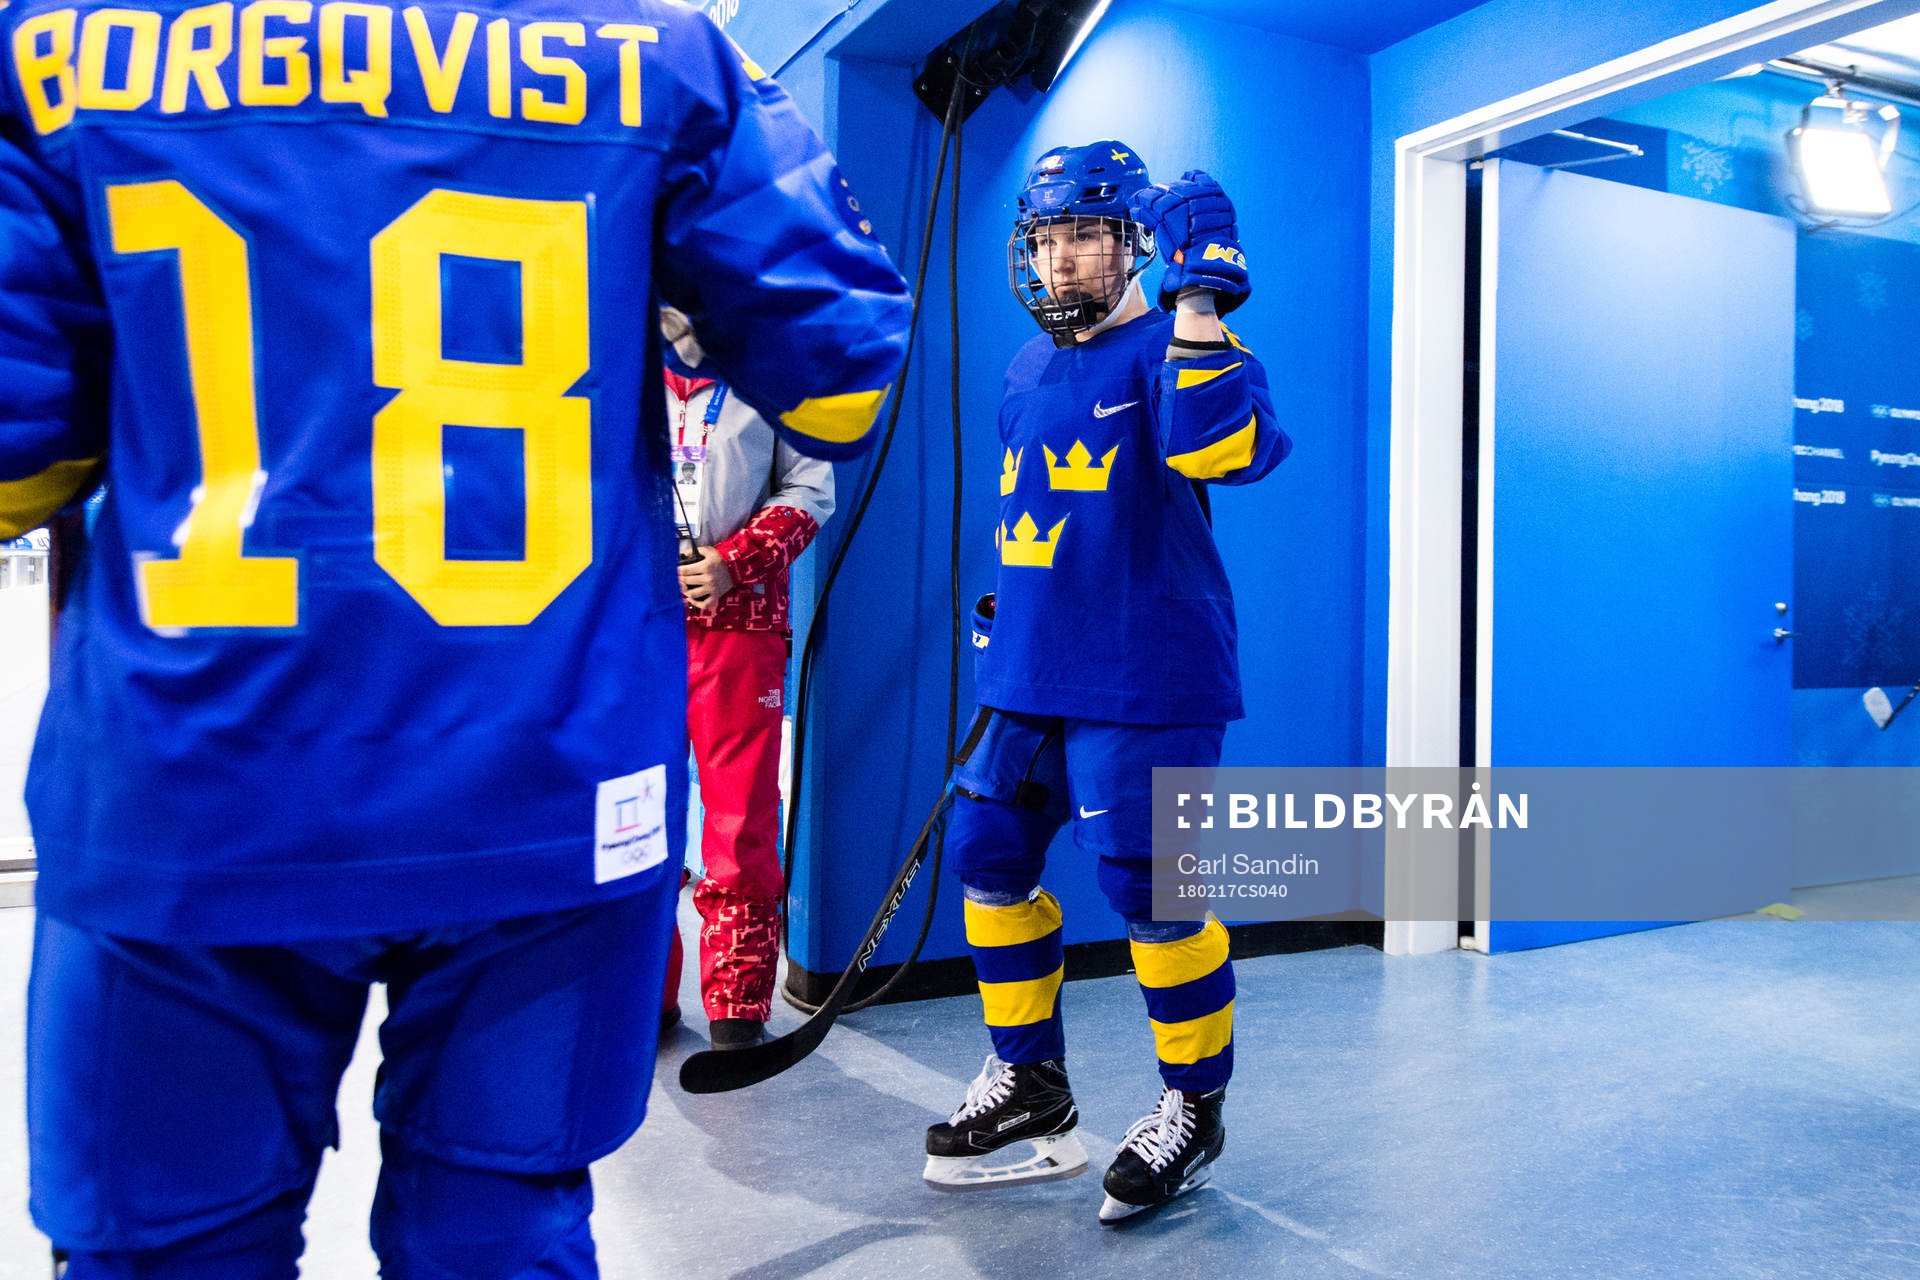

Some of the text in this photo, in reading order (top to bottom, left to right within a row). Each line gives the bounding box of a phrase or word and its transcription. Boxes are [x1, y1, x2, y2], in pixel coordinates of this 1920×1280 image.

[13, 0, 659, 135] BORGQVIST
[106, 180, 593, 628] 18
[858, 859, 921, 973] NEXUS
